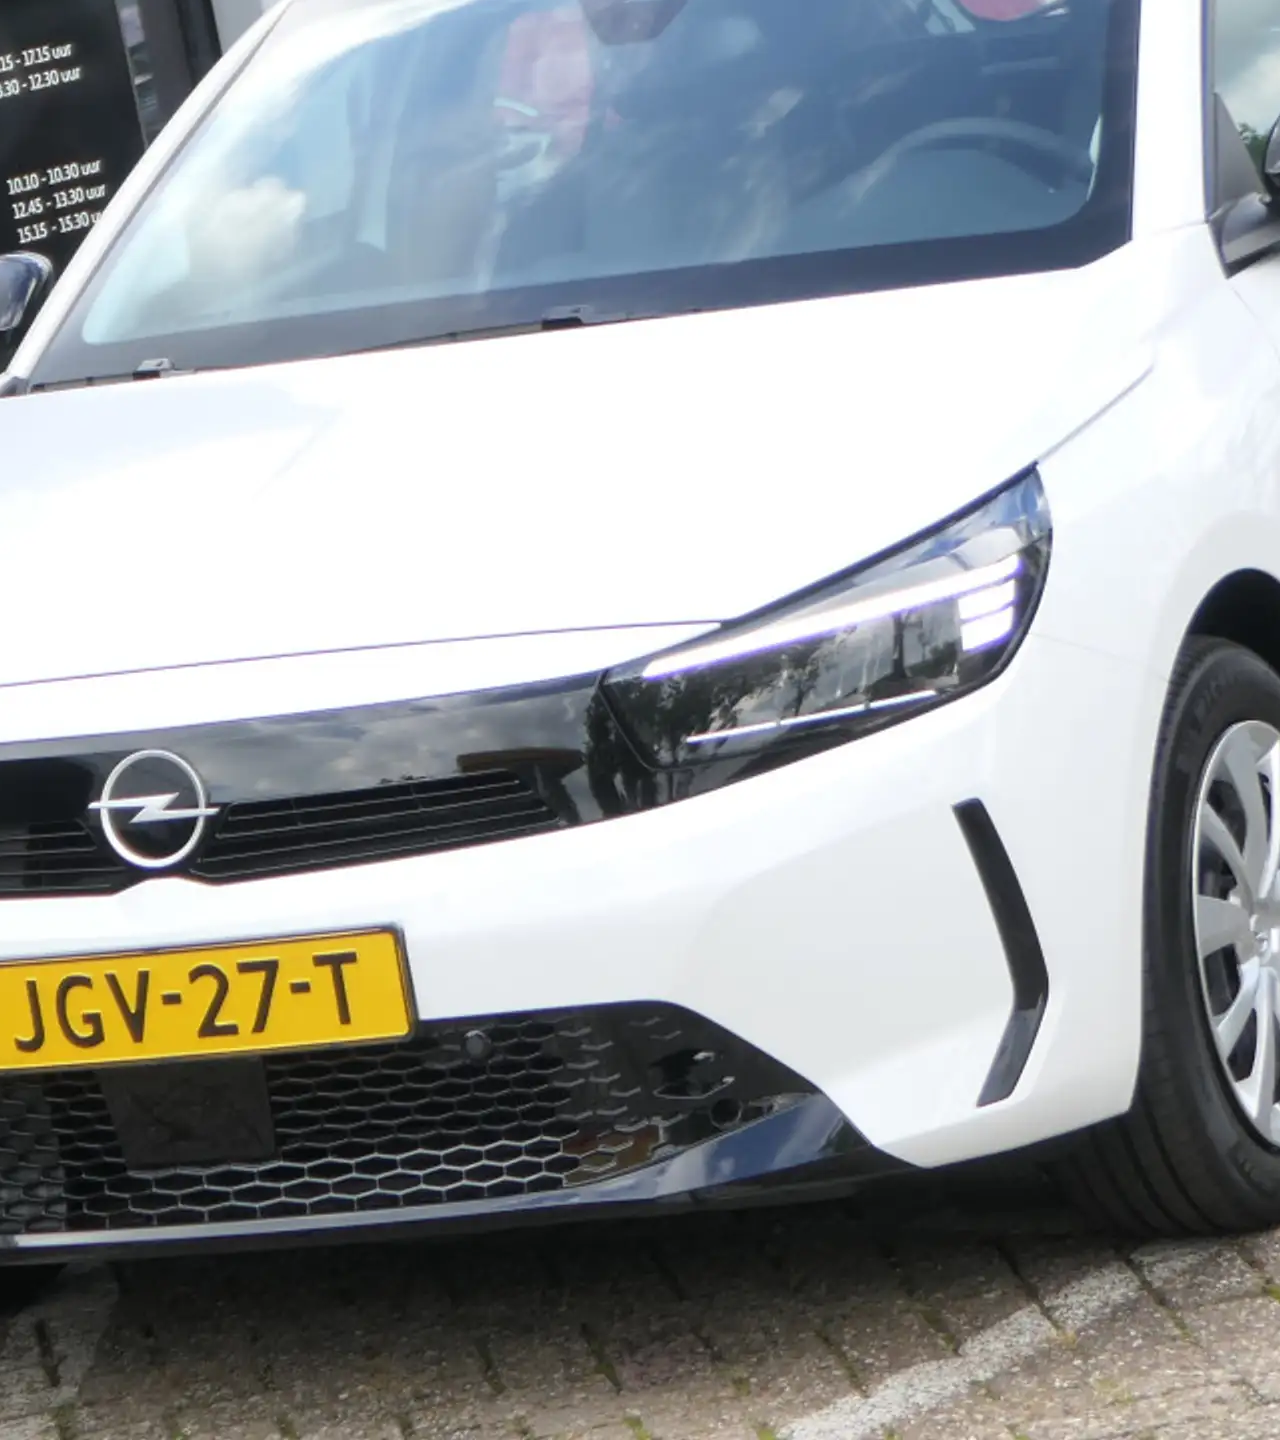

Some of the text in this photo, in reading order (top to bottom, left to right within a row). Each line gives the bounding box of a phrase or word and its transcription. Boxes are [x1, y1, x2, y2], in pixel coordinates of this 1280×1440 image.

[51, 43, 72, 59] uur
[60, 67, 81, 83] uur
[6, 173, 40, 195] 10.10
[80, 160, 101, 176] uur
[12, 197, 43, 220] 12.45
[85, 184, 106, 200] uur
[17, 222, 48, 244] 15.15
[14, 951, 357, 1053] JGV-27-T
